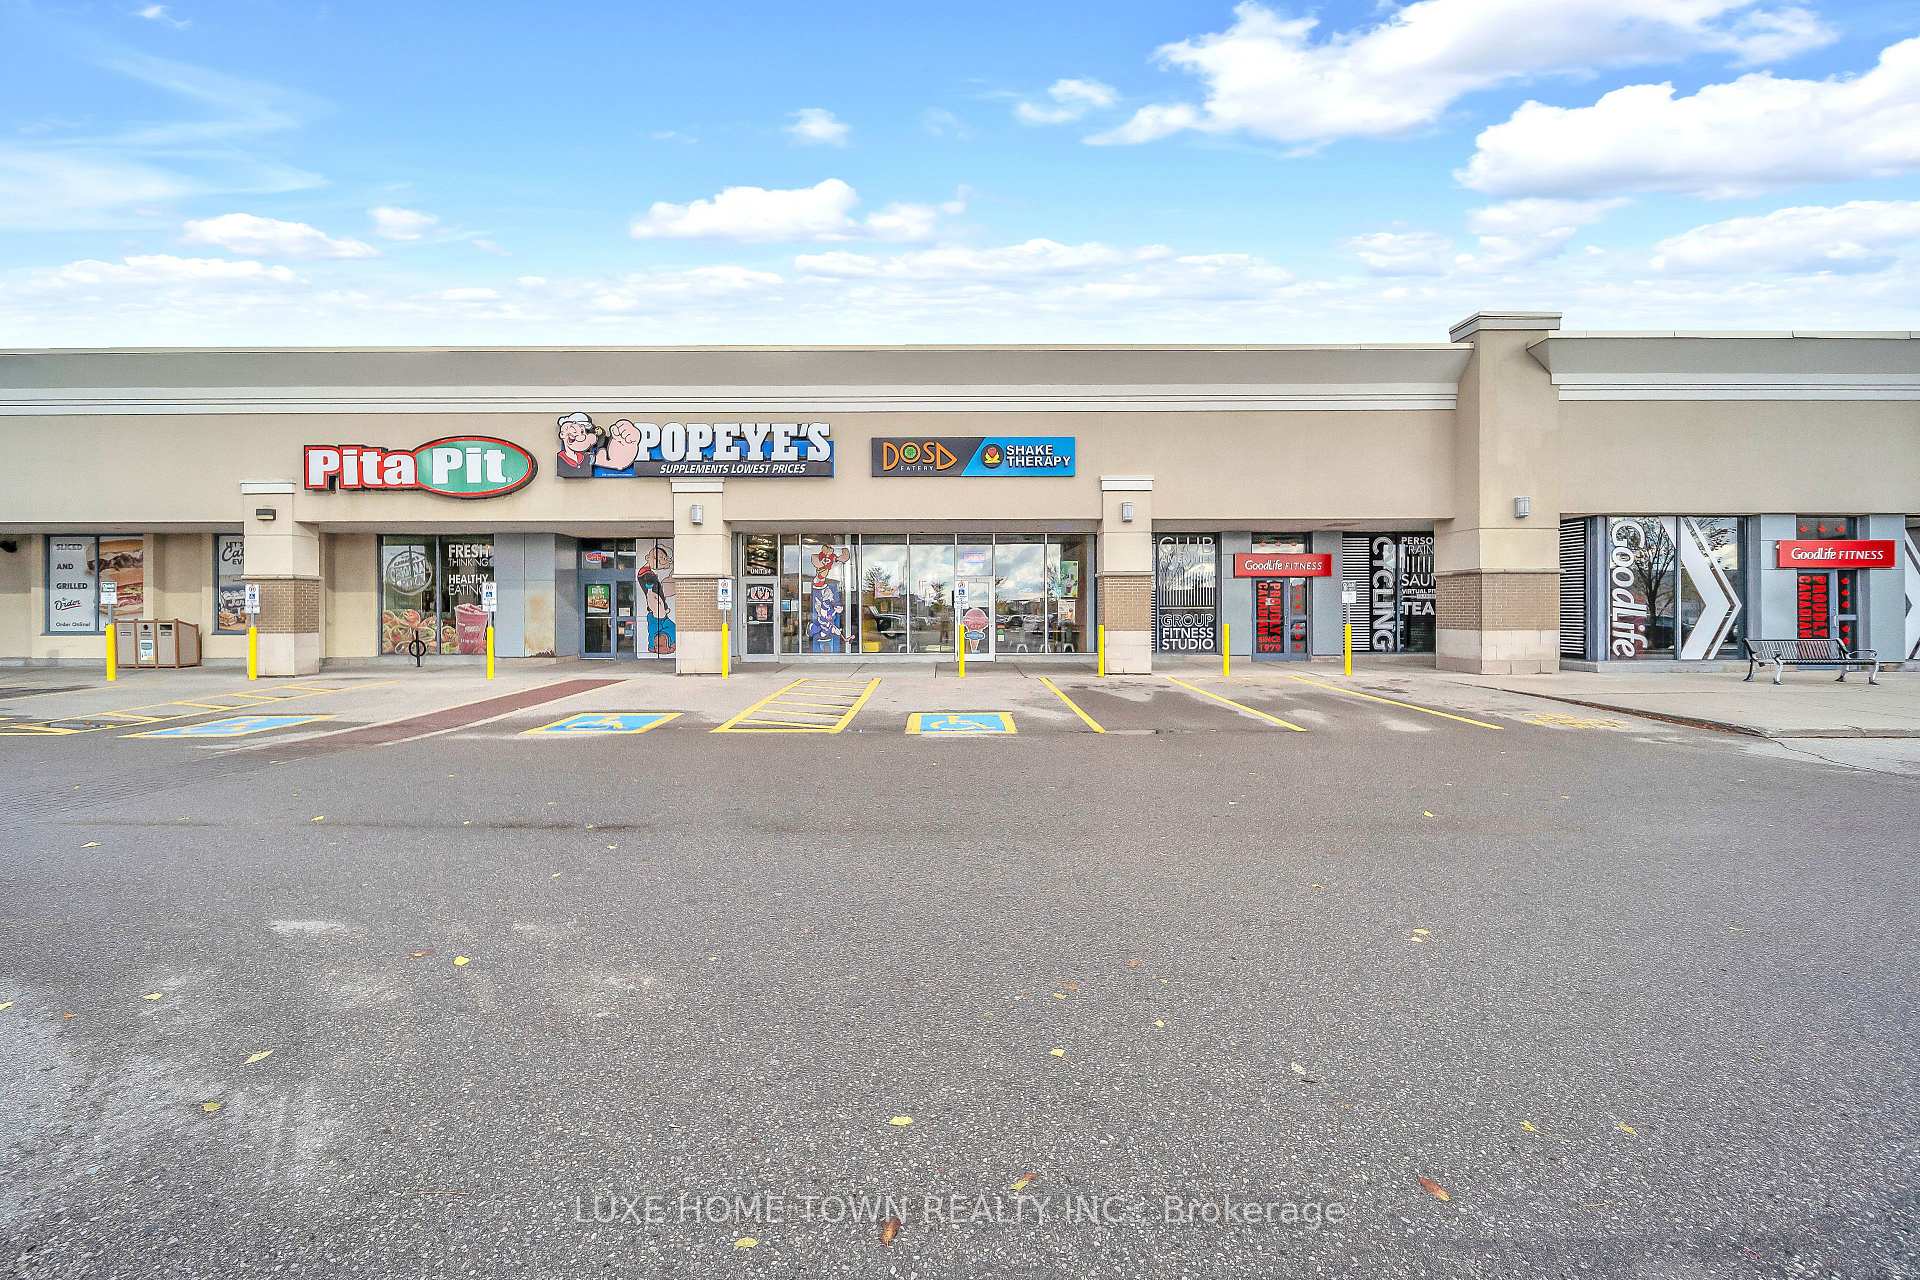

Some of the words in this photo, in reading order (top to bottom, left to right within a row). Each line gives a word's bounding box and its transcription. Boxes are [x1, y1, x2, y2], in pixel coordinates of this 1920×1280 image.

[635, 423, 831, 462] POPEYE'S
[1006, 445, 1053, 456] SHAKE
[308, 446, 416, 486] Pita
[432, 447, 509, 485] Pit
[1006, 456, 1071, 467] THERAPY
[660, 464, 729, 474] SUPPLEMENTS
[731, 464, 771, 473] LOWEST
[772, 464, 806, 473] PRICES
[56, 543, 83, 551] SLICED
[448, 544, 489, 558] FRESH
[1791, 547, 1837, 560] GoodLife
[1838, 550, 1884, 560] FITNESS
[1244, 559, 1283, 571] GoodLife
[1284, 561, 1323, 570] FITNESS
[448, 575, 489, 584] HEALTHY
[1373, 536, 1395, 652] CYCLING
[1611, 520, 1649, 658] GoodLife
[54, 599, 82, 611] Order
[1161, 614, 1214, 632] GROUP
[1162, 627, 1214, 639] FITNESS
[1162, 638, 1214, 650] STUDIO
